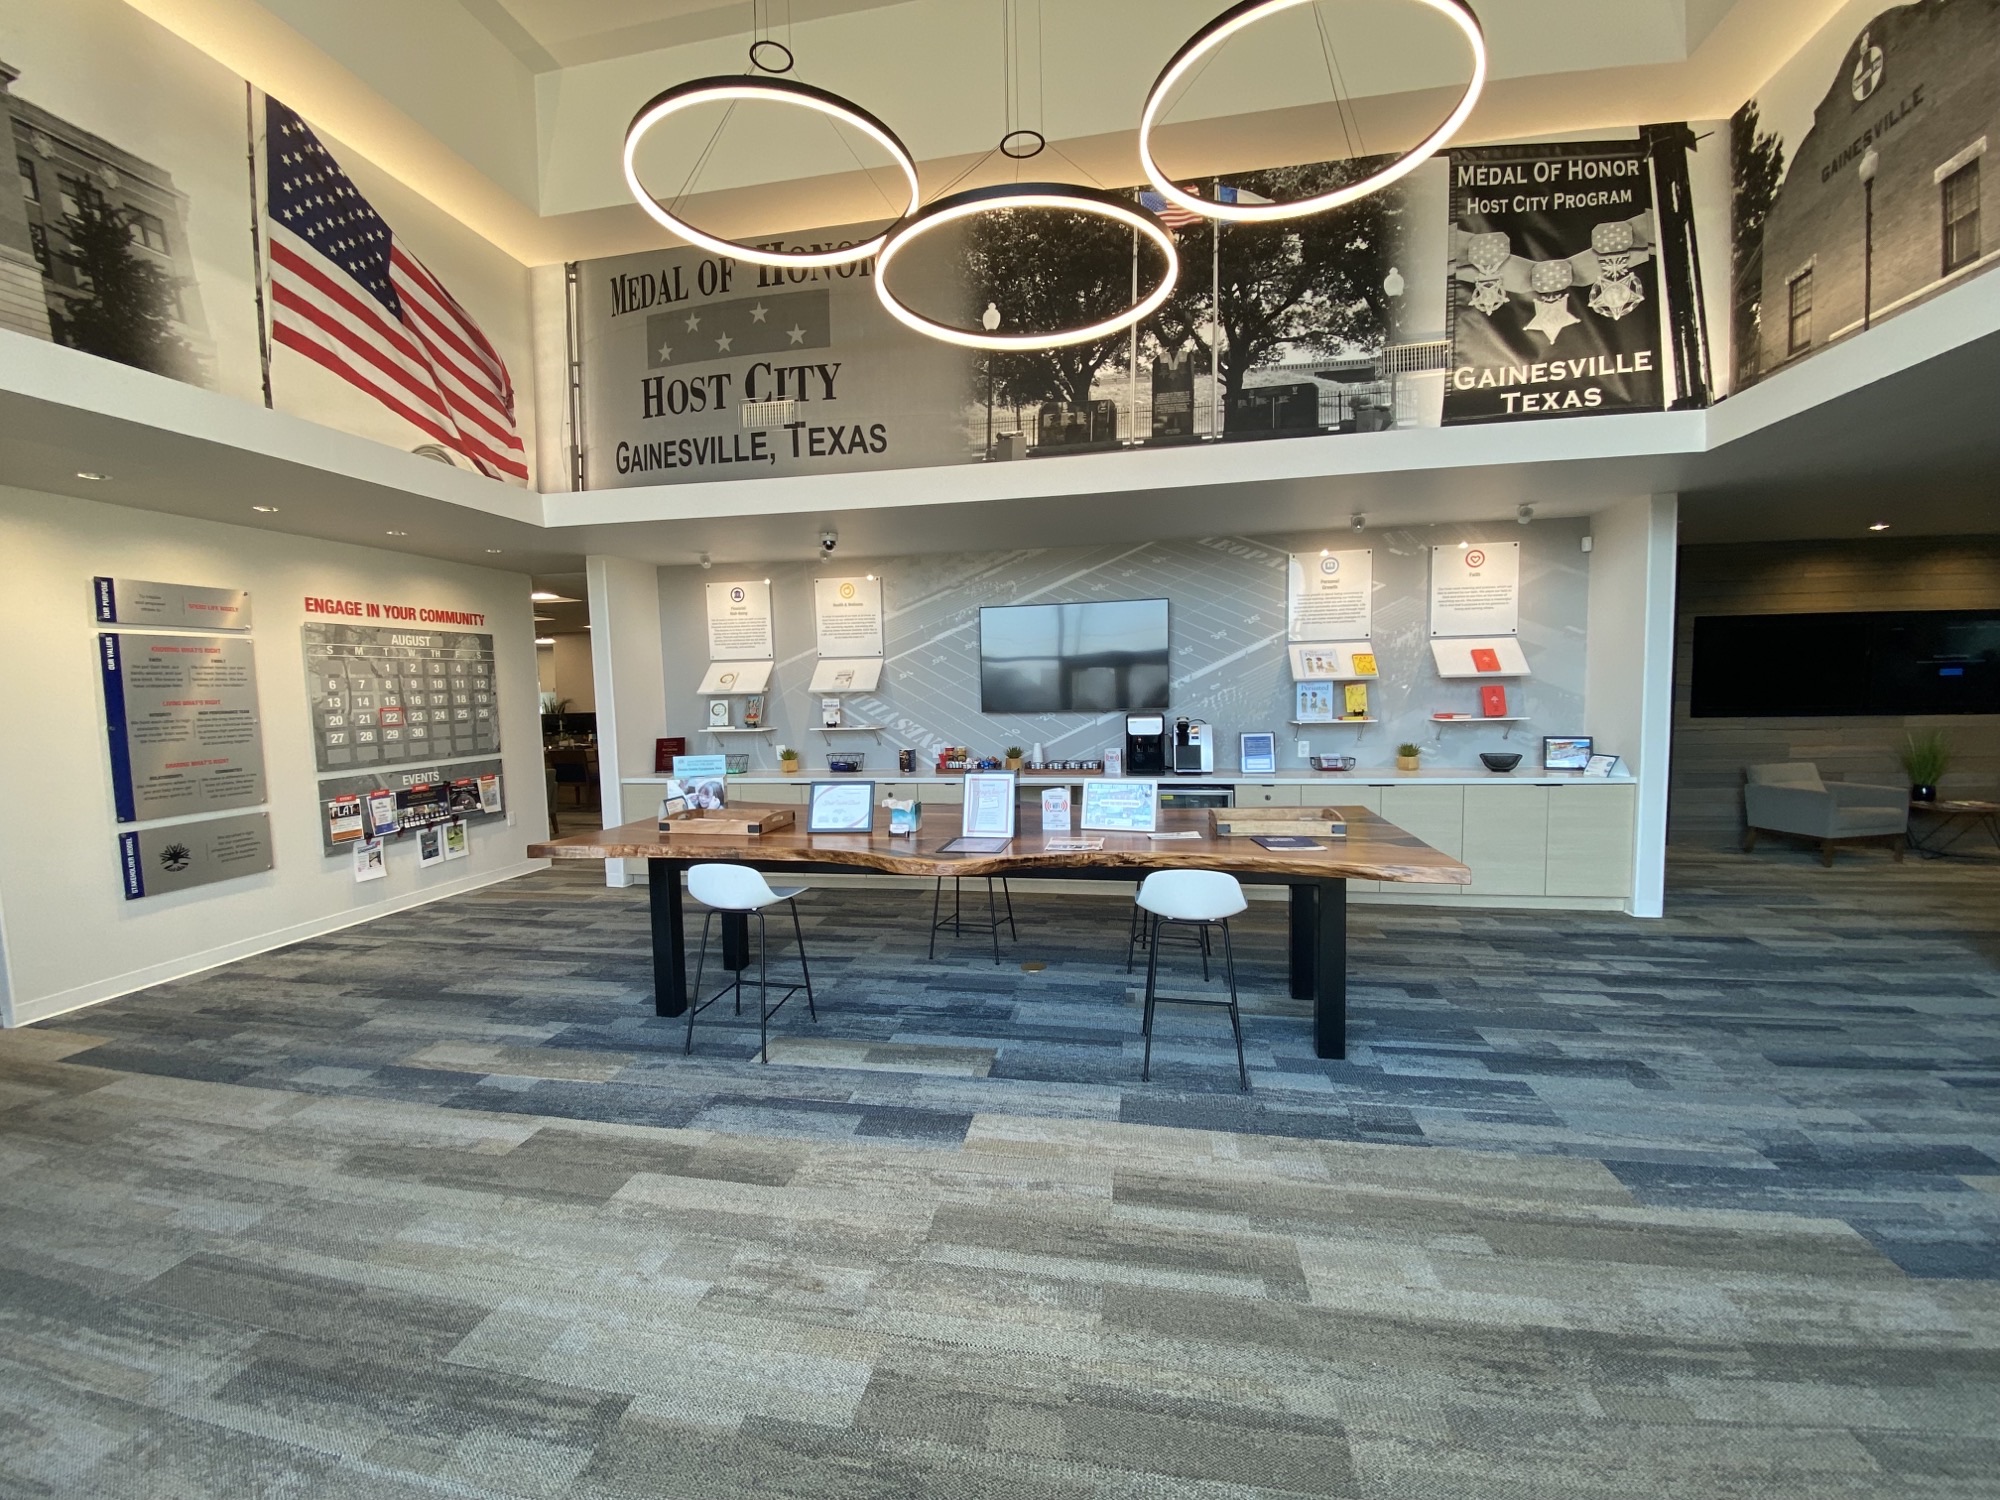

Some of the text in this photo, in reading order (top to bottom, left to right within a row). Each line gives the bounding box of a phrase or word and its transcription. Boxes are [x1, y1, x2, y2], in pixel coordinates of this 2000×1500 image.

[1821, 83, 1925, 184] GAINESVILLE
[1457, 159, 1640, 188] MEDAL OF HONOR
[1467, 189, 1632, 215] HOST CITY PROGRAM
[610, 265, 689, 317] MEDAL
[697, 256, 736, 297] OF
[1453, 351, 1653, 390] GAINESVILLE
[641, 362, 842, 420] HOST CITY
[1500, 387, 1602, 414] TEXAS
[615, 421, 888, 475] GAINESVILLE, TEXAS
[101, 581, 109, 606] PURPOSE
[304, 596, 485, 626] ENGAGE IN YOUR COMMUNITY
[326, 646, 334, 655] S
[354, 646, 363, 655] M
[383, 647, 389, 656] T
[407, 649, 415, 657] W
[430, 649, 440, 658] TH
[476, 652, 481, 660] S
[391, 634, 431, 647] AUGUST
[385, 663, 482, 674] 1 2 3 4 5
[328, 679, 485, 689] 6 7 8 9 10 11 12
[327, 694, 487, 707] 13 14 15 16 17 18 19
[329, 709, 488, 726] 20 21 22 23 24 25 26
[331, 728, 424, 744] 27 28 29 30
[402, 771, 440, 785] EVENTS
